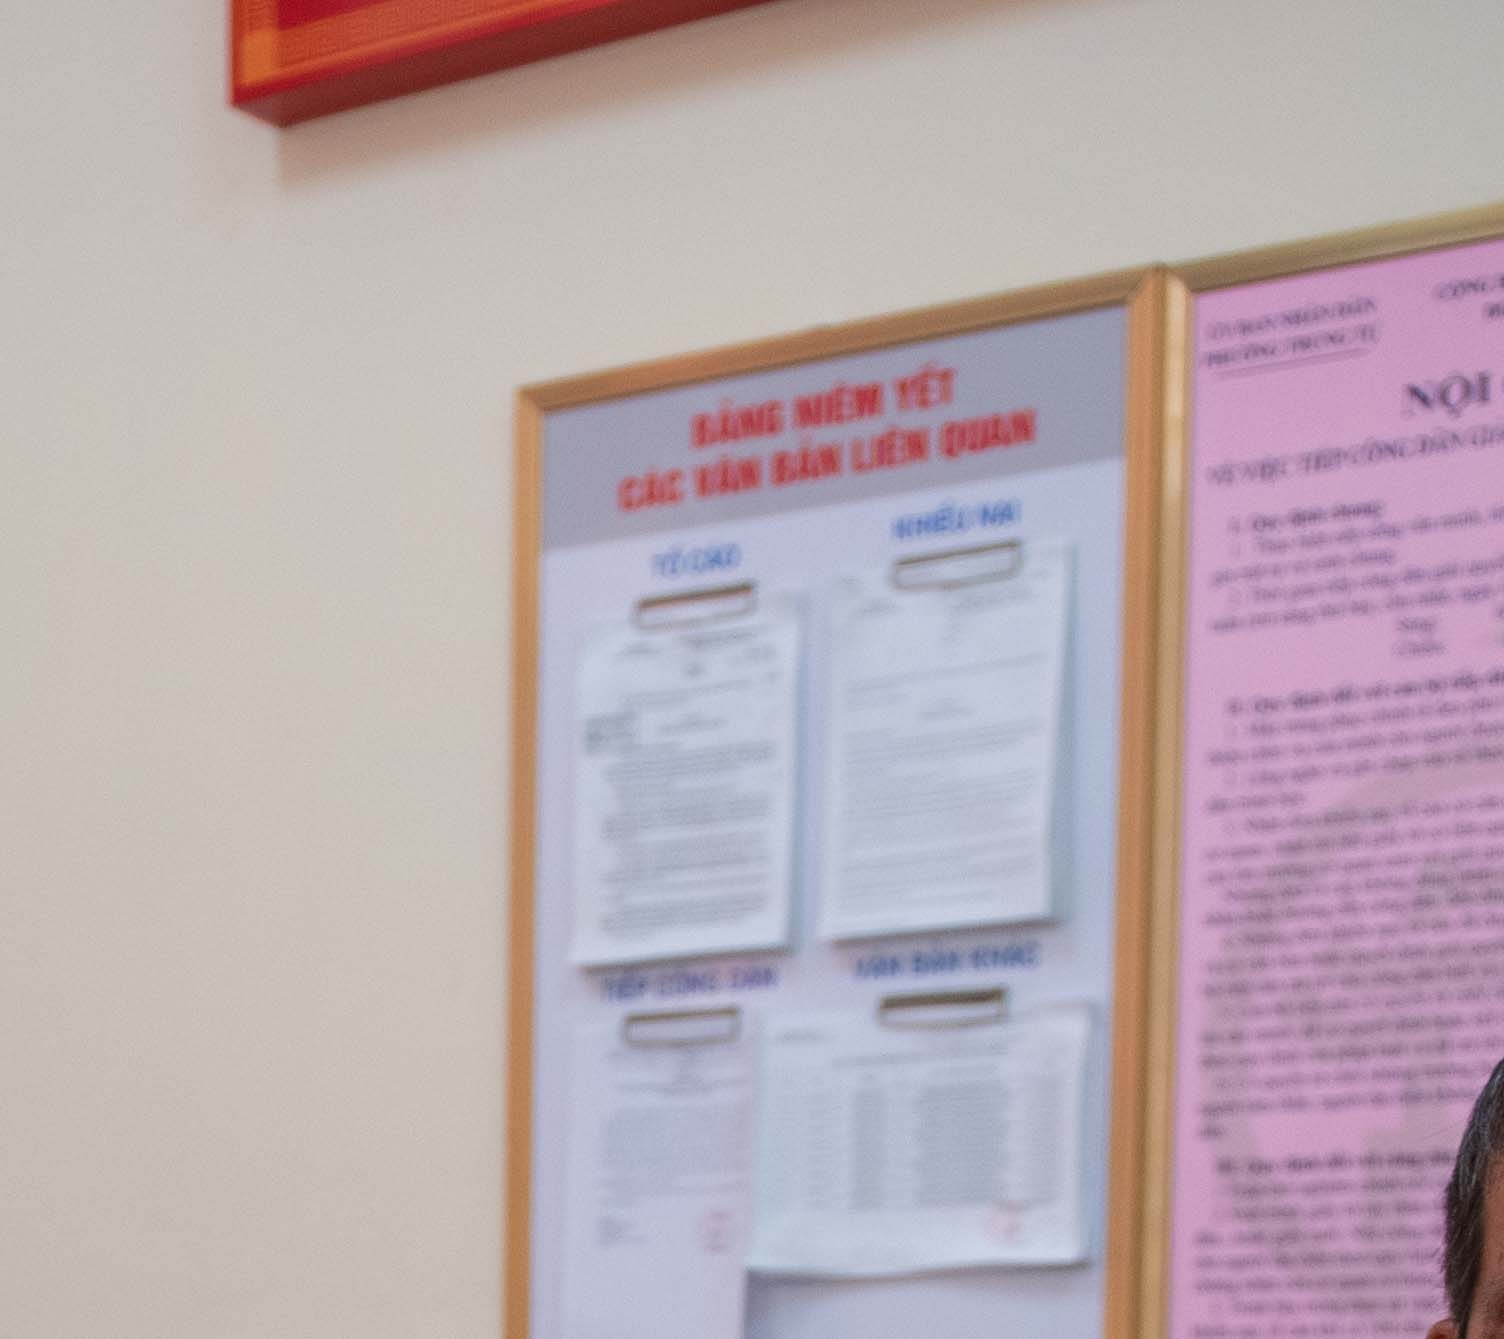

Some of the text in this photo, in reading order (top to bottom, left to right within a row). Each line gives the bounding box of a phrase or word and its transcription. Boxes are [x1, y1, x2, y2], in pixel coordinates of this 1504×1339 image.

[891, 365, 955, 410] YẾT
[1404, 371, 1491, 417] NỘI
[616, 468, 684, 512] CÁC
[850, 427, 930, 472] LIÊN
[939, 411, 1035, 458] QUAN
